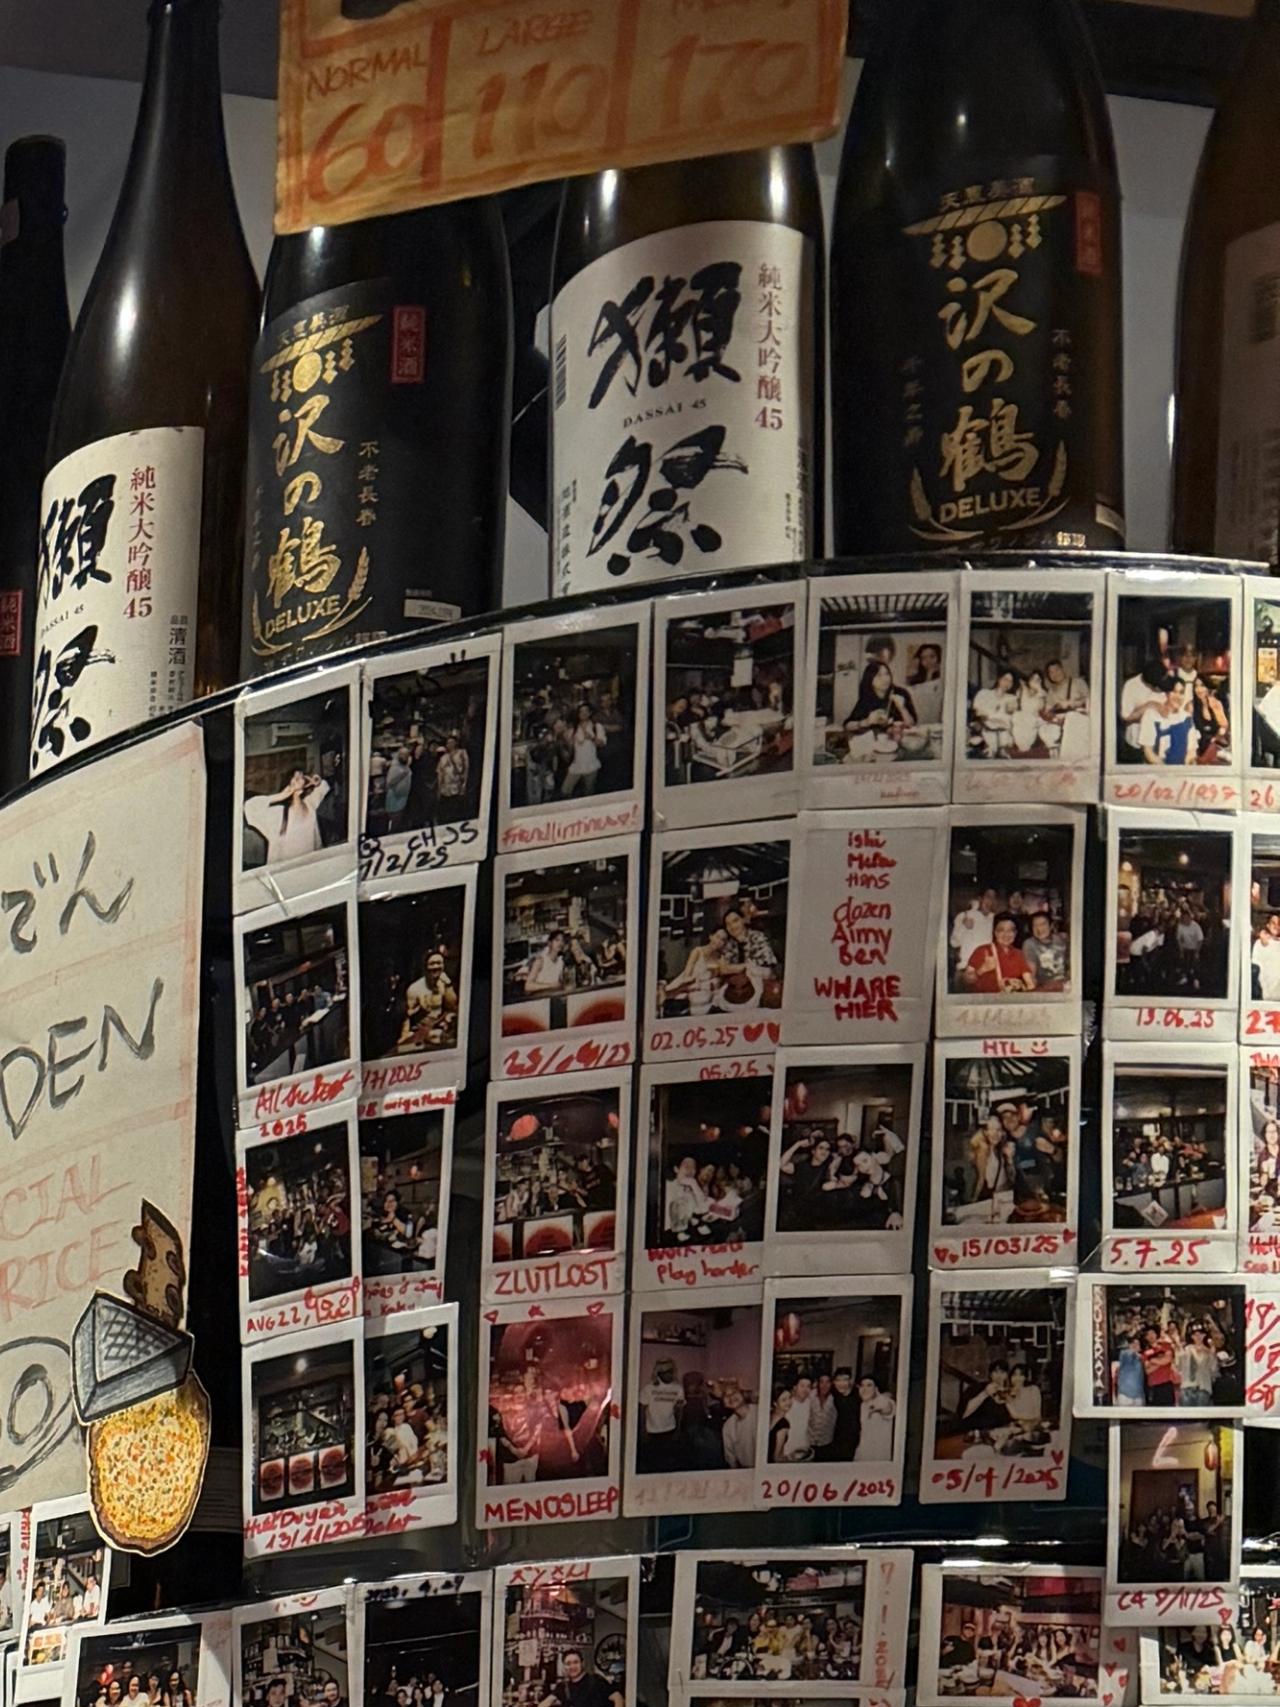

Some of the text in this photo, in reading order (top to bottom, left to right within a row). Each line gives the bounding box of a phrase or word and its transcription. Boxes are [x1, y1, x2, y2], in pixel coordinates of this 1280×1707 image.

[304, 9, 594, 100] NORMAL LARGE
[304, 33, 810, 201] 60 110 170
[938, 268, 1040, 492] 沢の鶴
[622, 403, 685, 429] DASSAI
[266, 395, 345, 609] 沢の鶴
[939, 486, 1041, 522] DELUXE
[264, 597, 340, 638] DELUXE
[1110, 1240, 1211, 1266] 5.7.25
